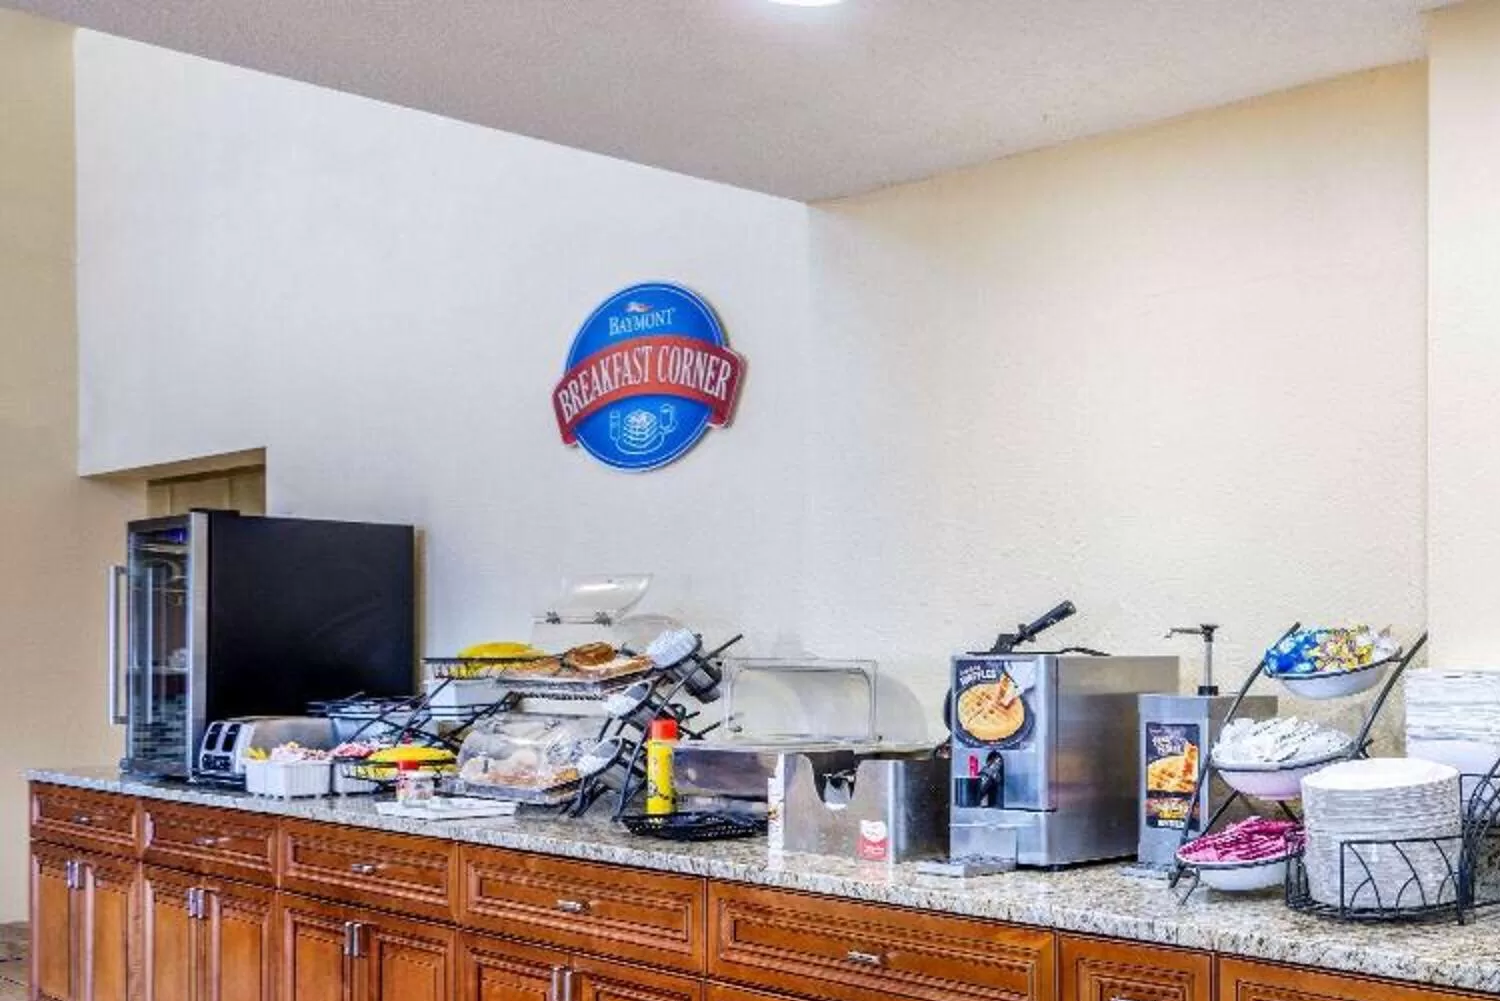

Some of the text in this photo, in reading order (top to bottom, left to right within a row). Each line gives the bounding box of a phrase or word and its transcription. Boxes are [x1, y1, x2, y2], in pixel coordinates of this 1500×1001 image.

[608, 310, 673, 336] BAYMONT
[558, 346, 731, 424] BREAKFAST CORNER
